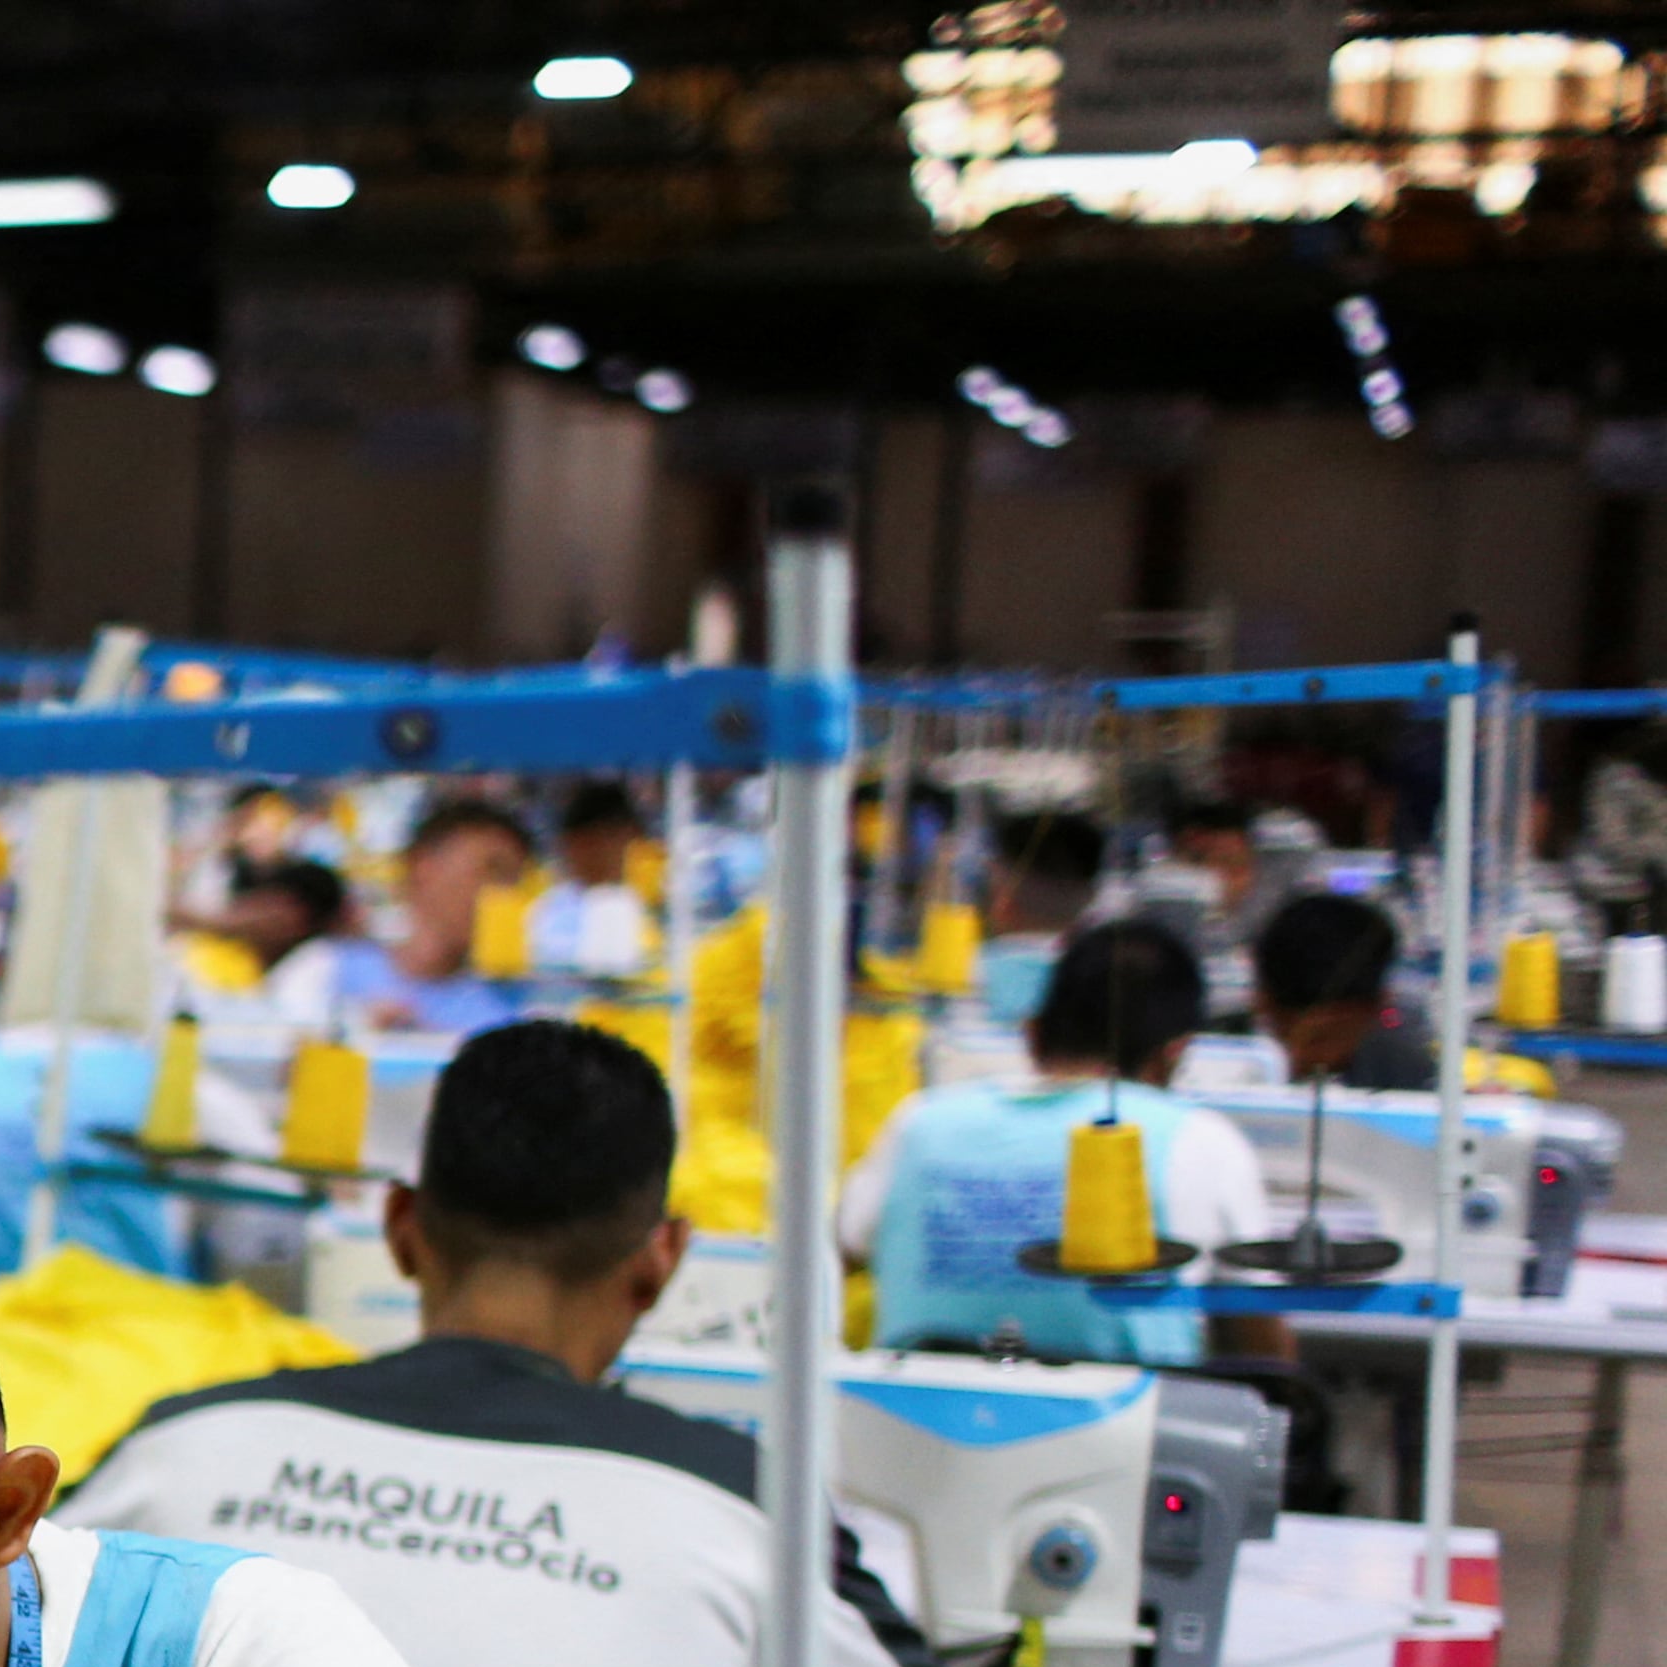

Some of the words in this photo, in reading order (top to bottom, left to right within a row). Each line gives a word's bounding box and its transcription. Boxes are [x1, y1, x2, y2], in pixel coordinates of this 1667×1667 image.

[272, 1458, 565, 1538] MAQUILA
[209, 1496, 622, 1593] #PlanCeroOcio
[16, 1584, 32, 1618] 42
